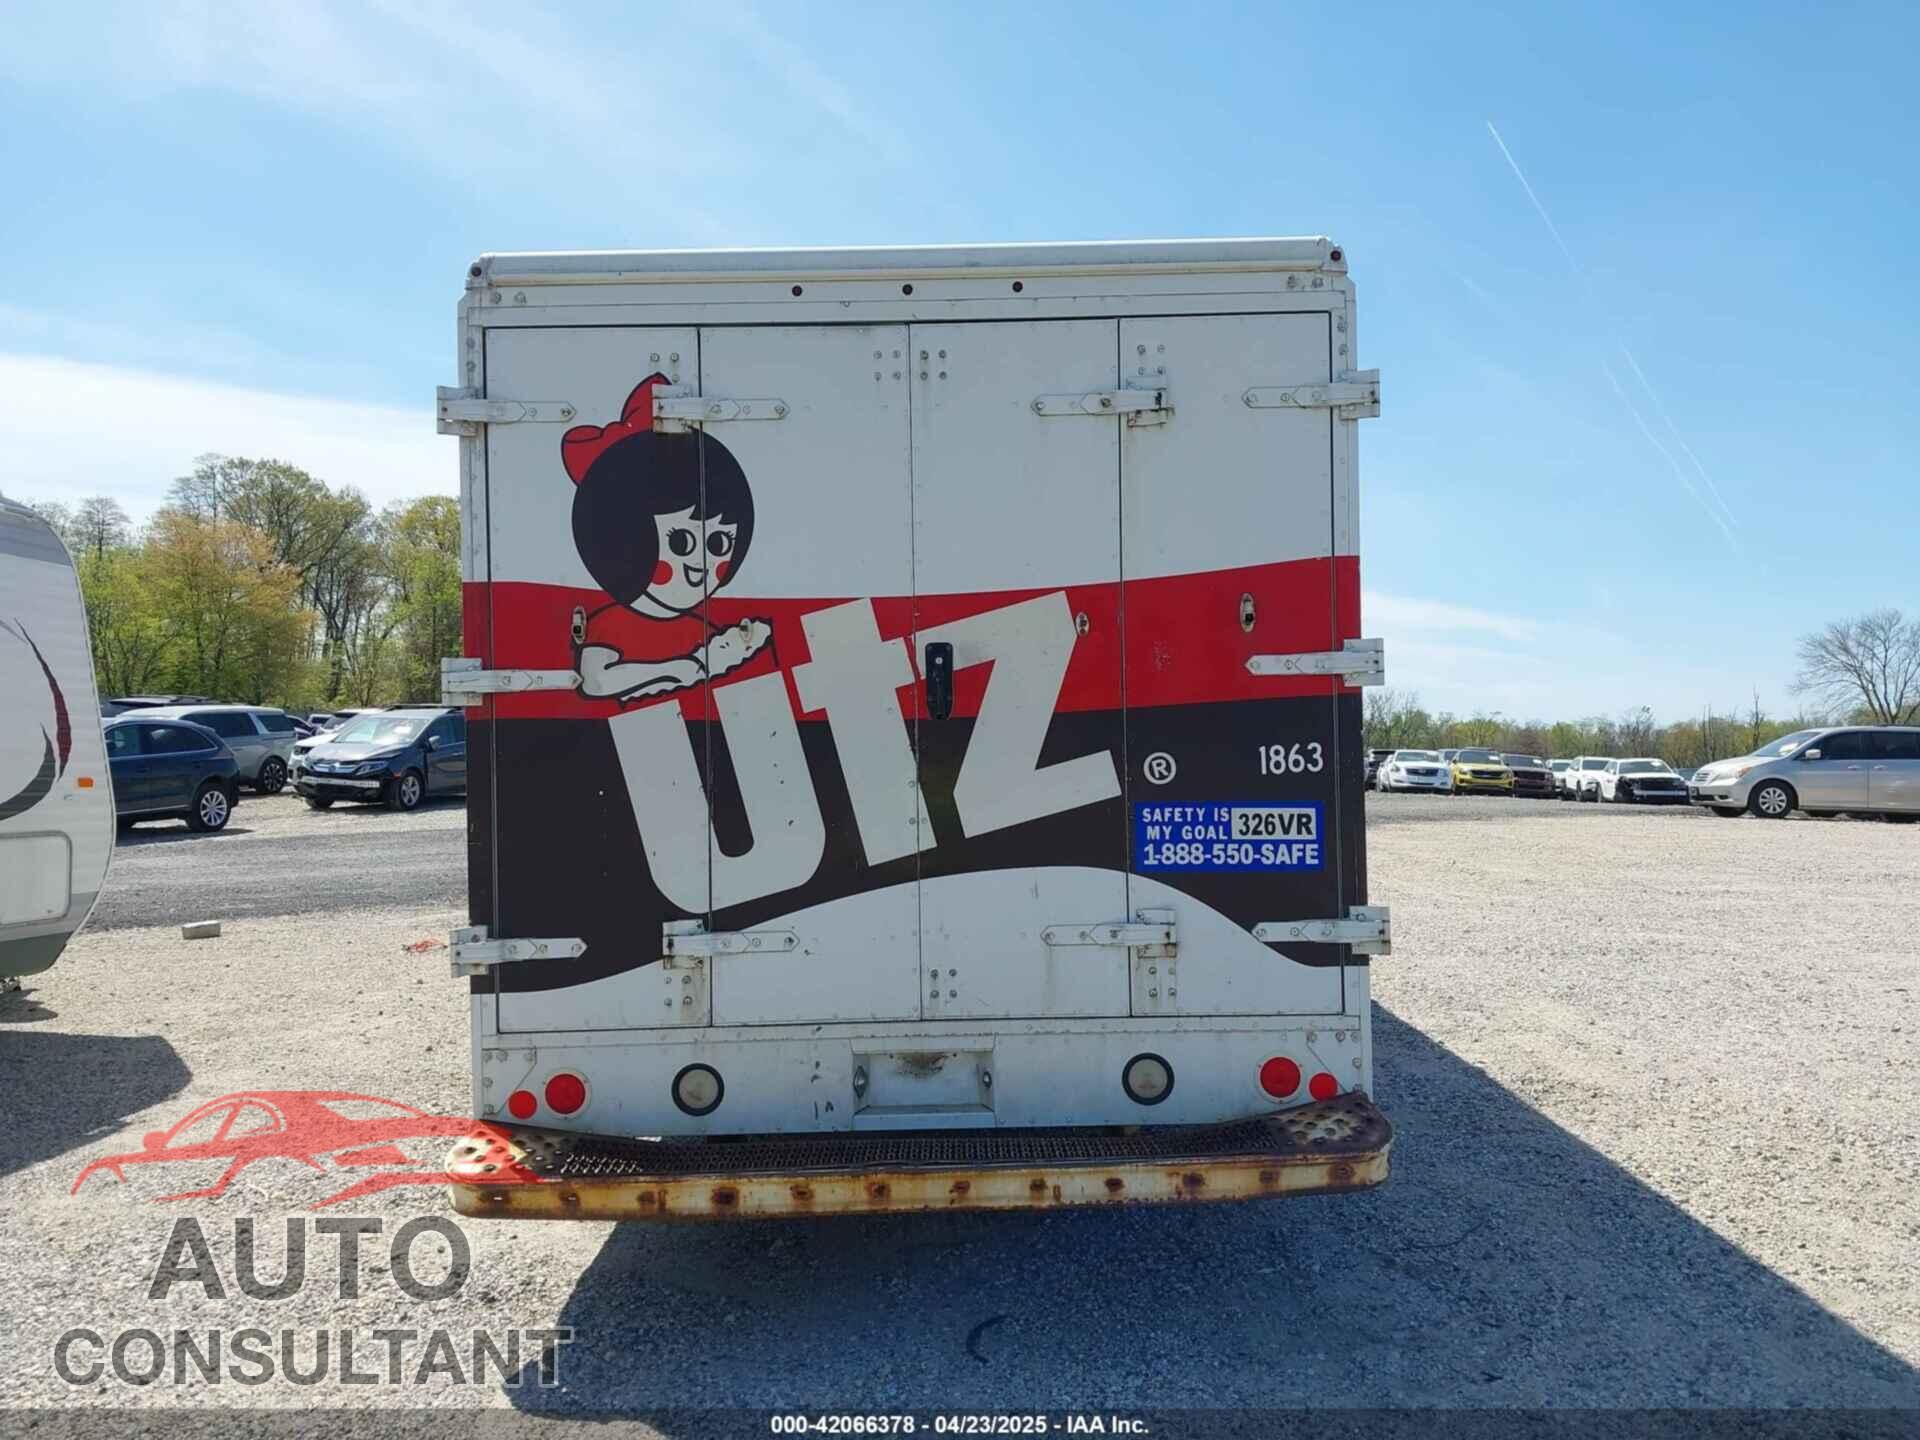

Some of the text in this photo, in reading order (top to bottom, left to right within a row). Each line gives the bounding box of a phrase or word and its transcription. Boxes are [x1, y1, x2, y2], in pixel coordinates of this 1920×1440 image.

[1259, 742, 1324, 776] 1863
[1142, 807, 1230, 823] SAFETY IS
[1238, 812, 1313, 837] 326VR
[1146, 824, 1229, 840] MY GOAL
[1143, 843, 1319, 865] 1-888-550-SAFE
